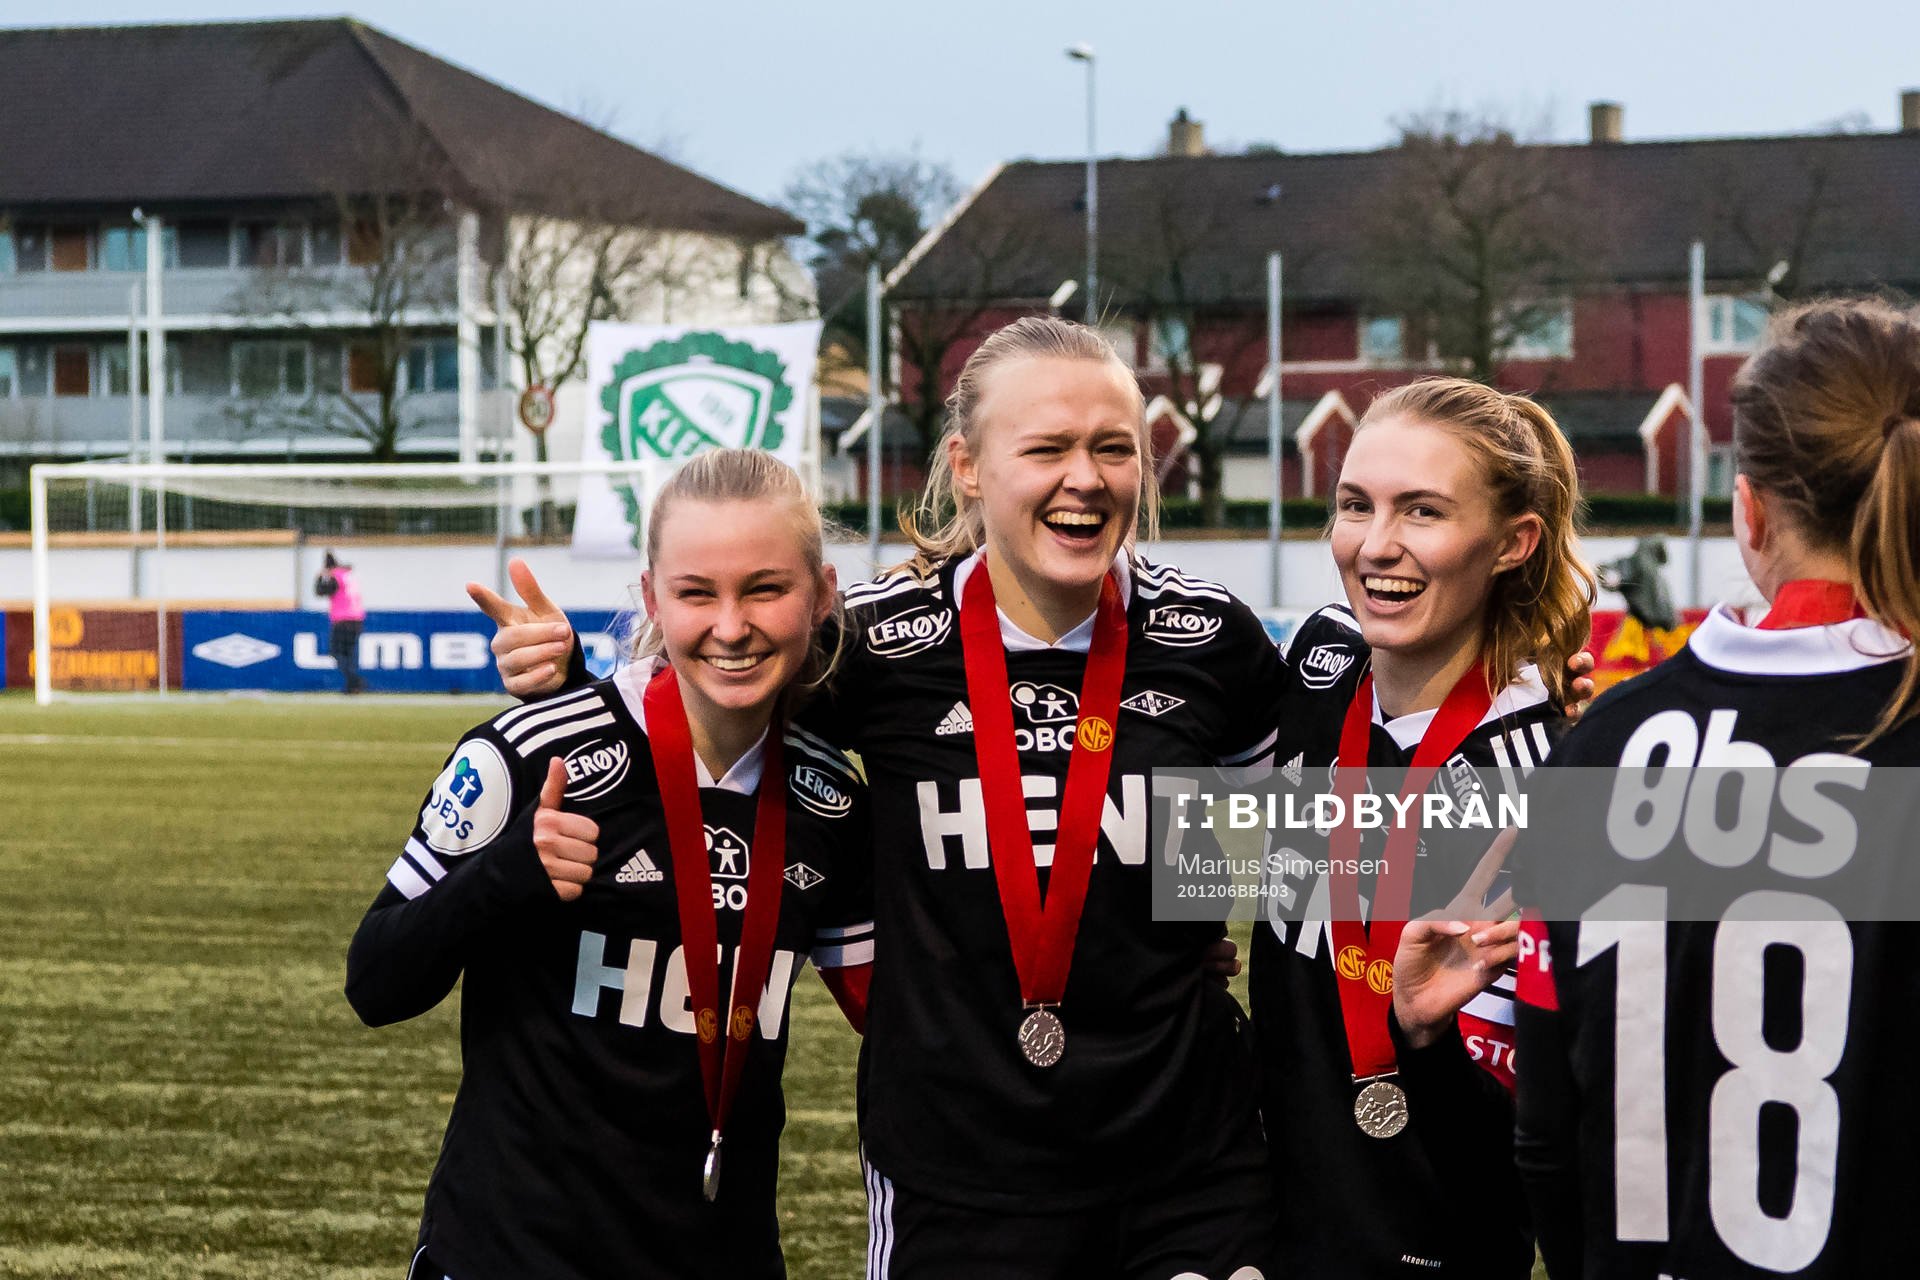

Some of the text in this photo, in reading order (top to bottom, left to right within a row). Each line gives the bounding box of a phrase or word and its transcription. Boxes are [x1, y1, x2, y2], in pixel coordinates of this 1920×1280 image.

[868, 611, 946, 646] LERØY
[1306, 646, 1351, 674] LERØY
[935, 721, 974, 736] adida
[1014, 725, 1076, 752] OBO
[566, 743, 622, 785] ERØY
[795, 765, 848, 807] LERØY
[615, 870, 663, 883] adidas
[1576, 883, 1854, 1274] 18
